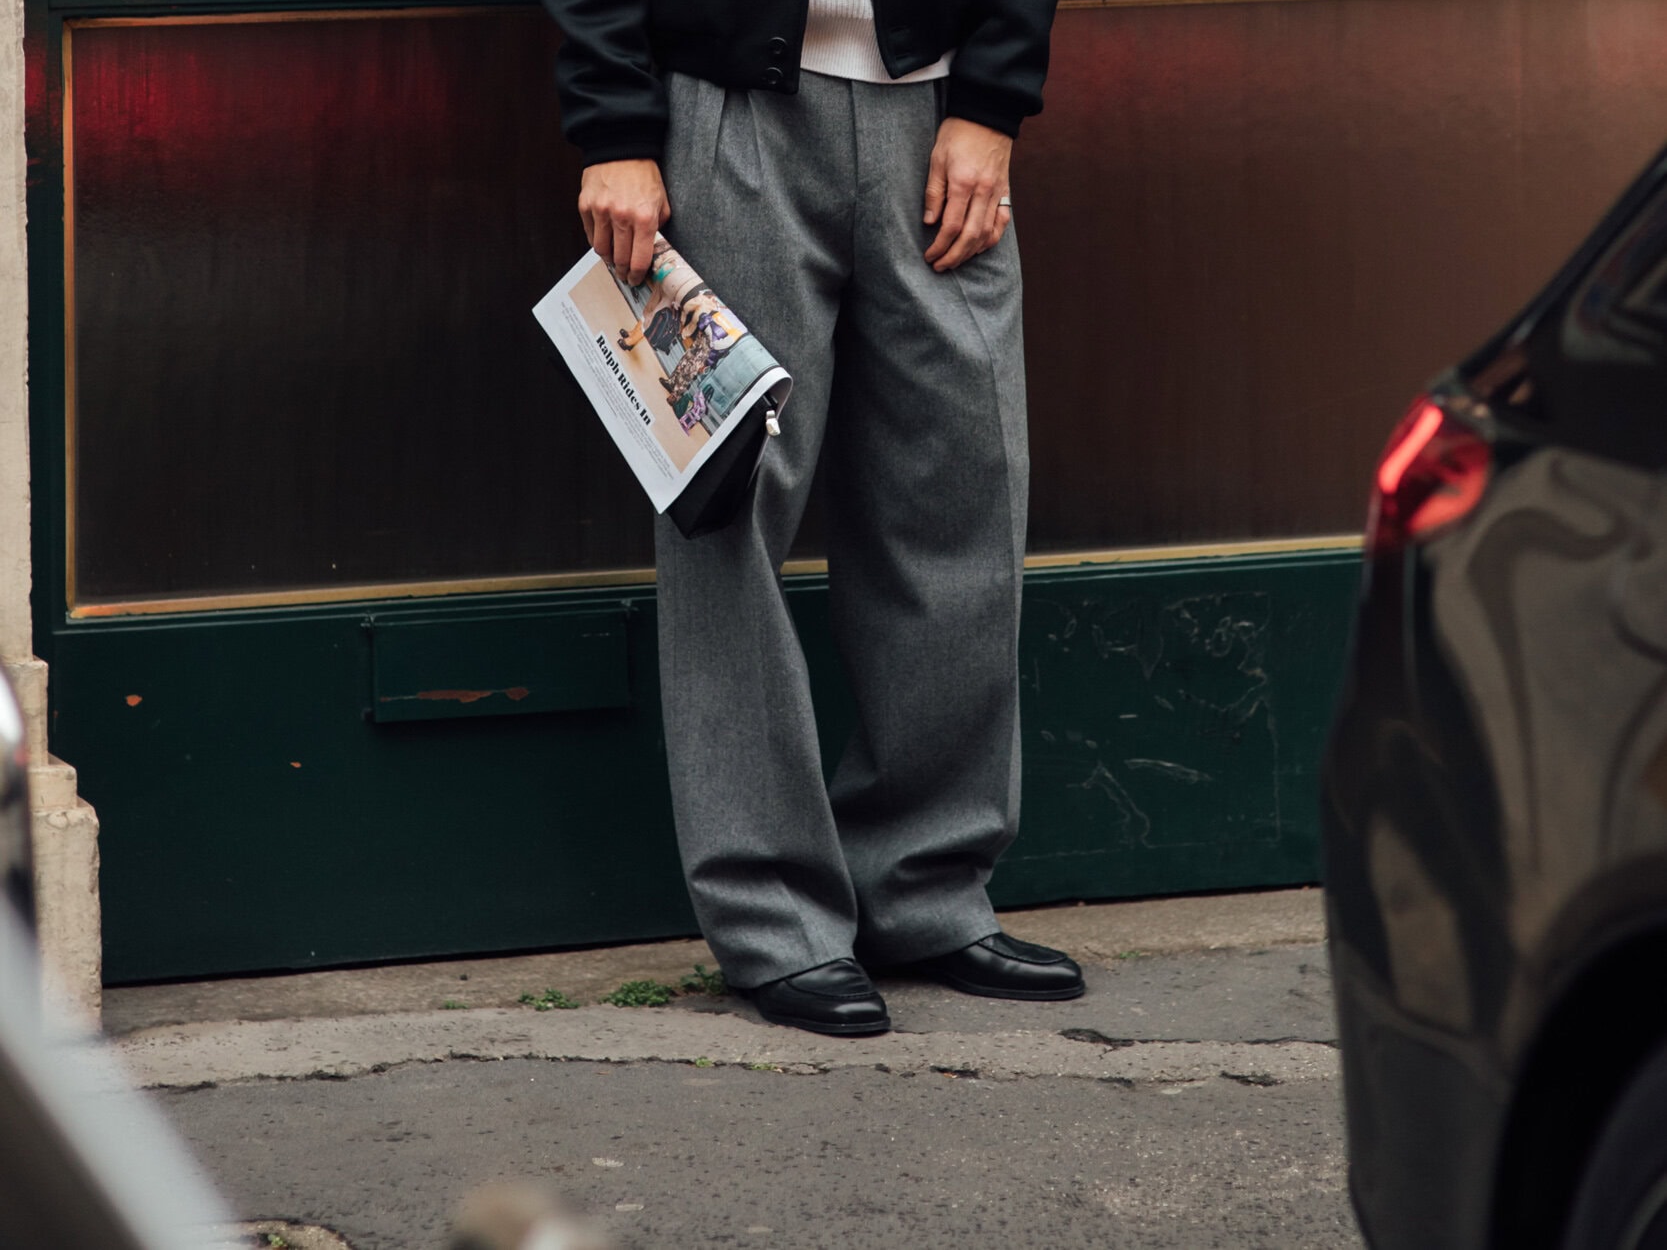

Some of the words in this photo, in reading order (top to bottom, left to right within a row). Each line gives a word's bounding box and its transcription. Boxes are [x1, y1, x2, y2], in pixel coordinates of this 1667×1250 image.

[596, 335, 620, 375] Ralph
[618, 373, 640, 410] Rides
[639, 408, 651, 425] In
